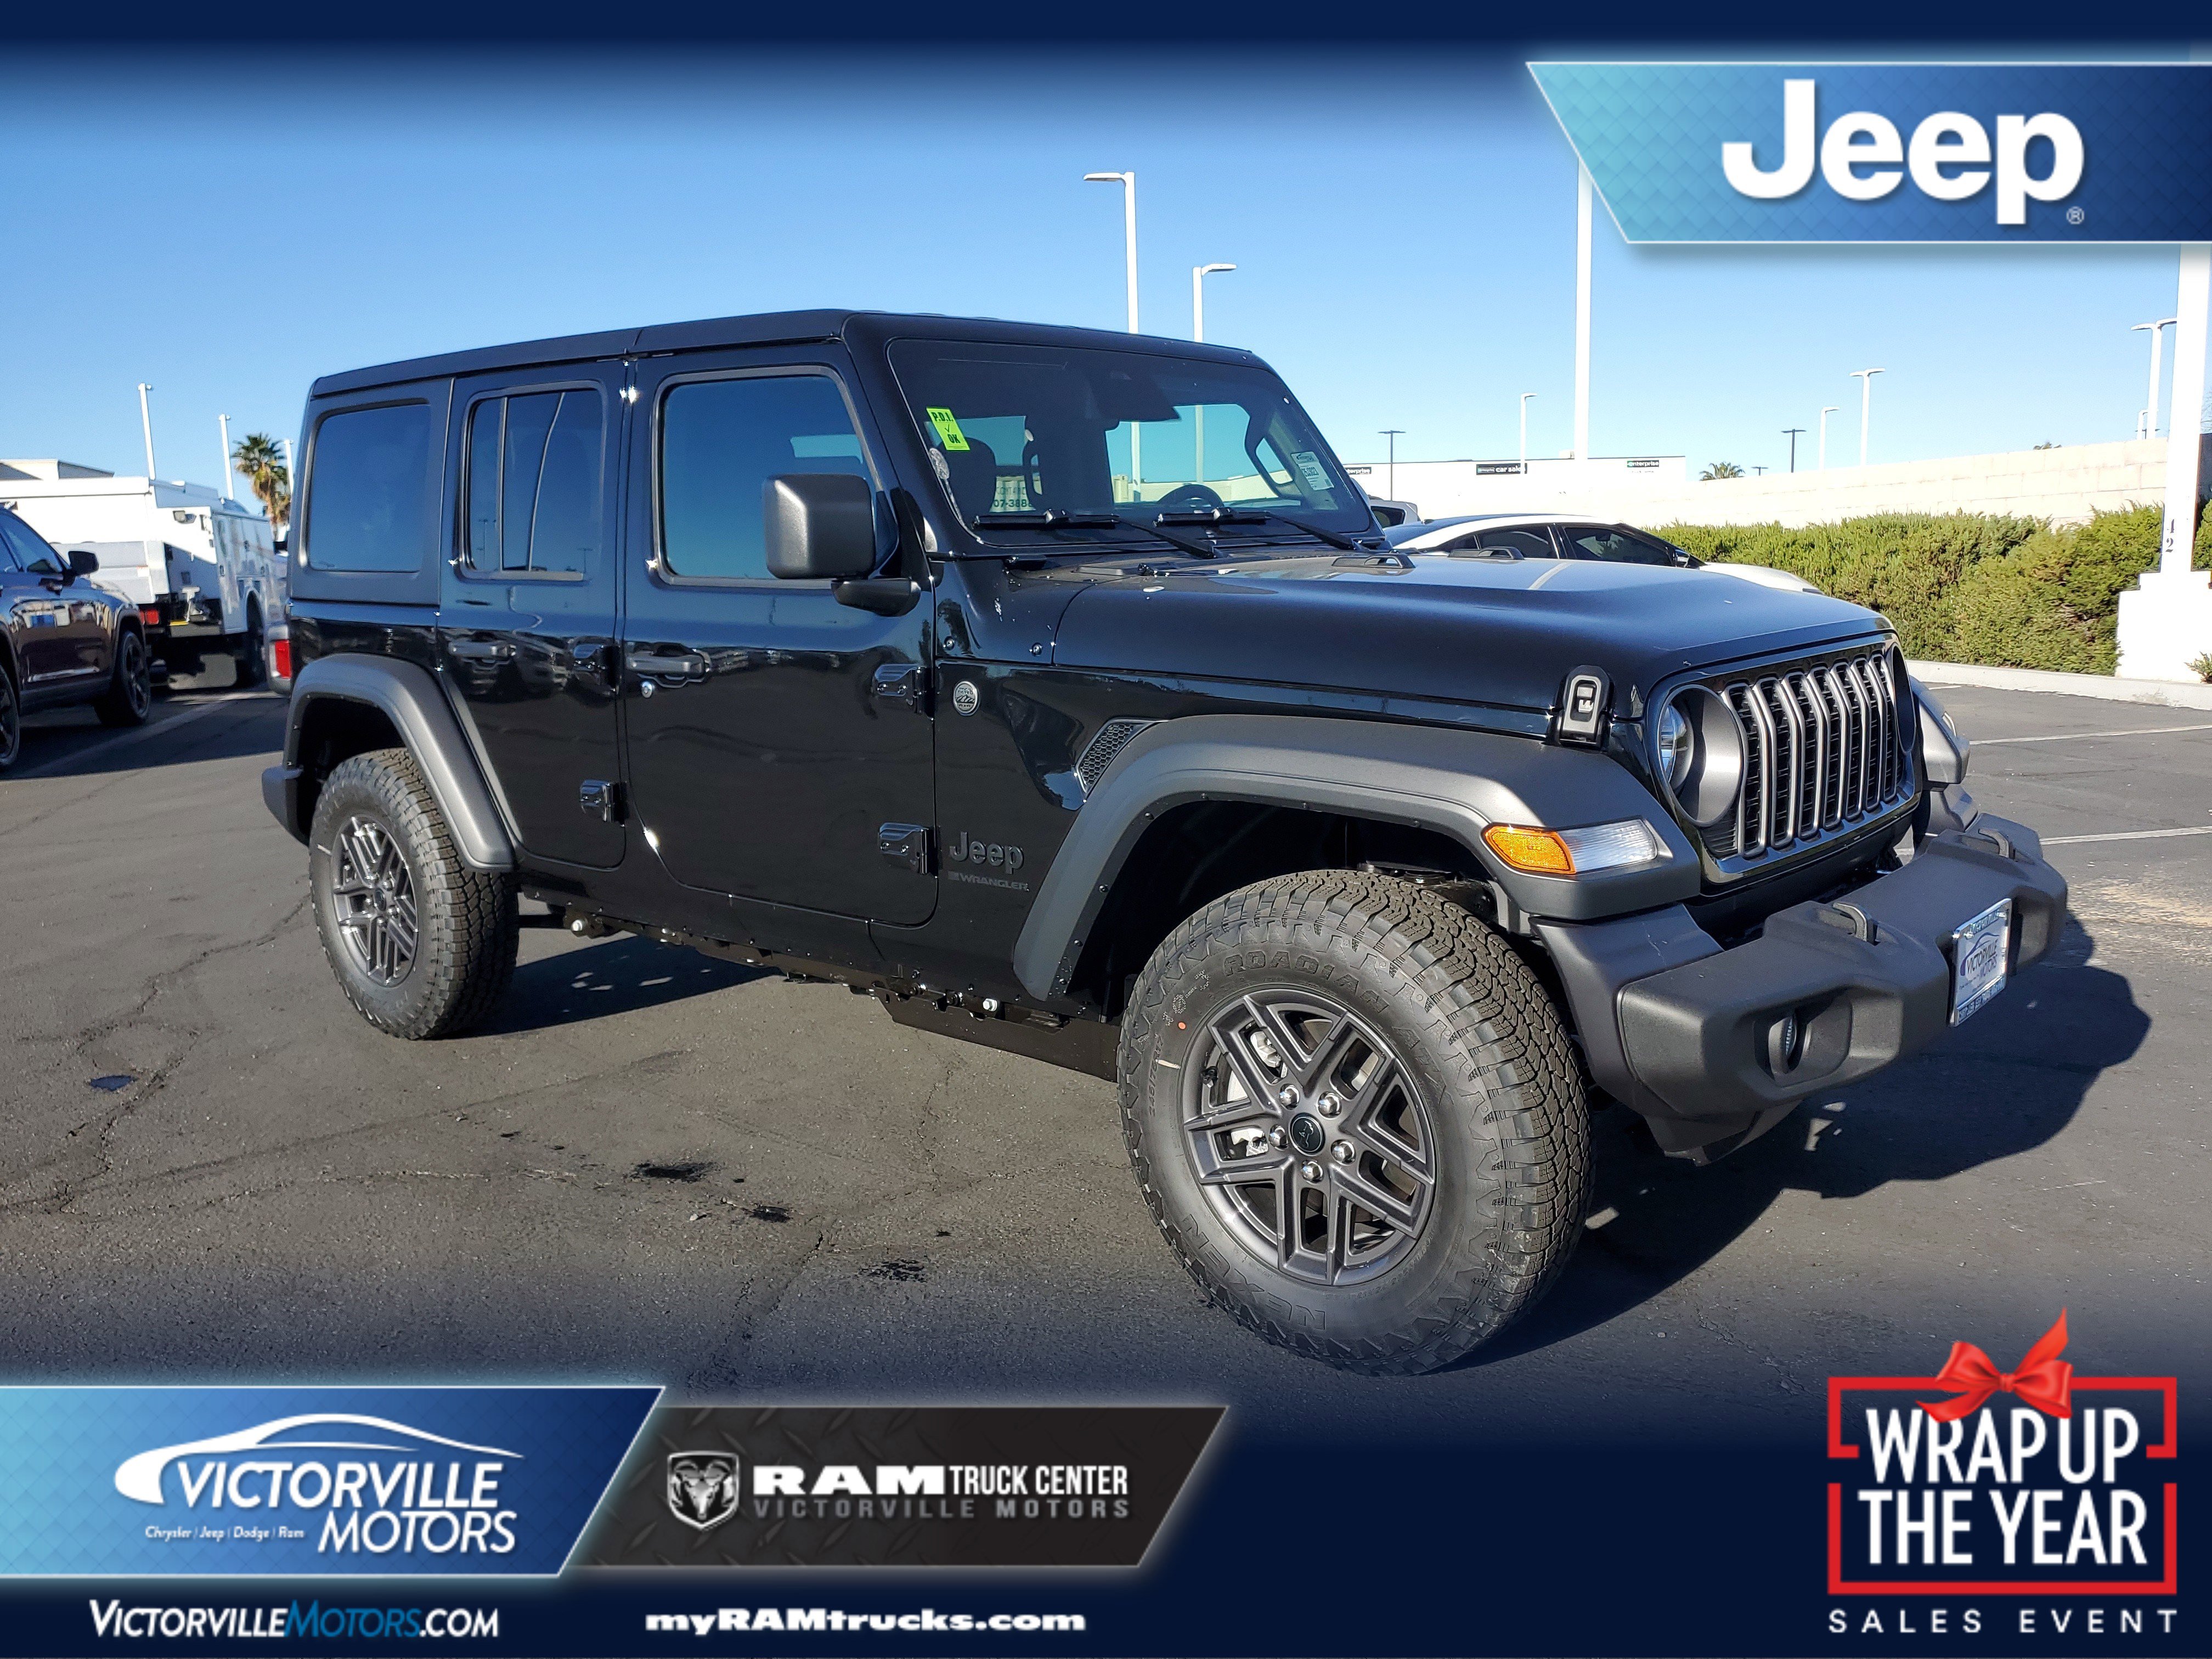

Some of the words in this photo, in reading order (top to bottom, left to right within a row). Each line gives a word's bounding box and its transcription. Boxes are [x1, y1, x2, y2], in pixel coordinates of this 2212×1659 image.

[930, 411, 954, 422] P.D.I.
[947, 433, 961, 444] OK
[949, 831, 1025, 875] Jeep
[960, 872, 1030, 892] WRANGLER
[1223, 950, 1389, 1013] ROADIAN
[1181, 1213, 1326, 1330] NEXEN
